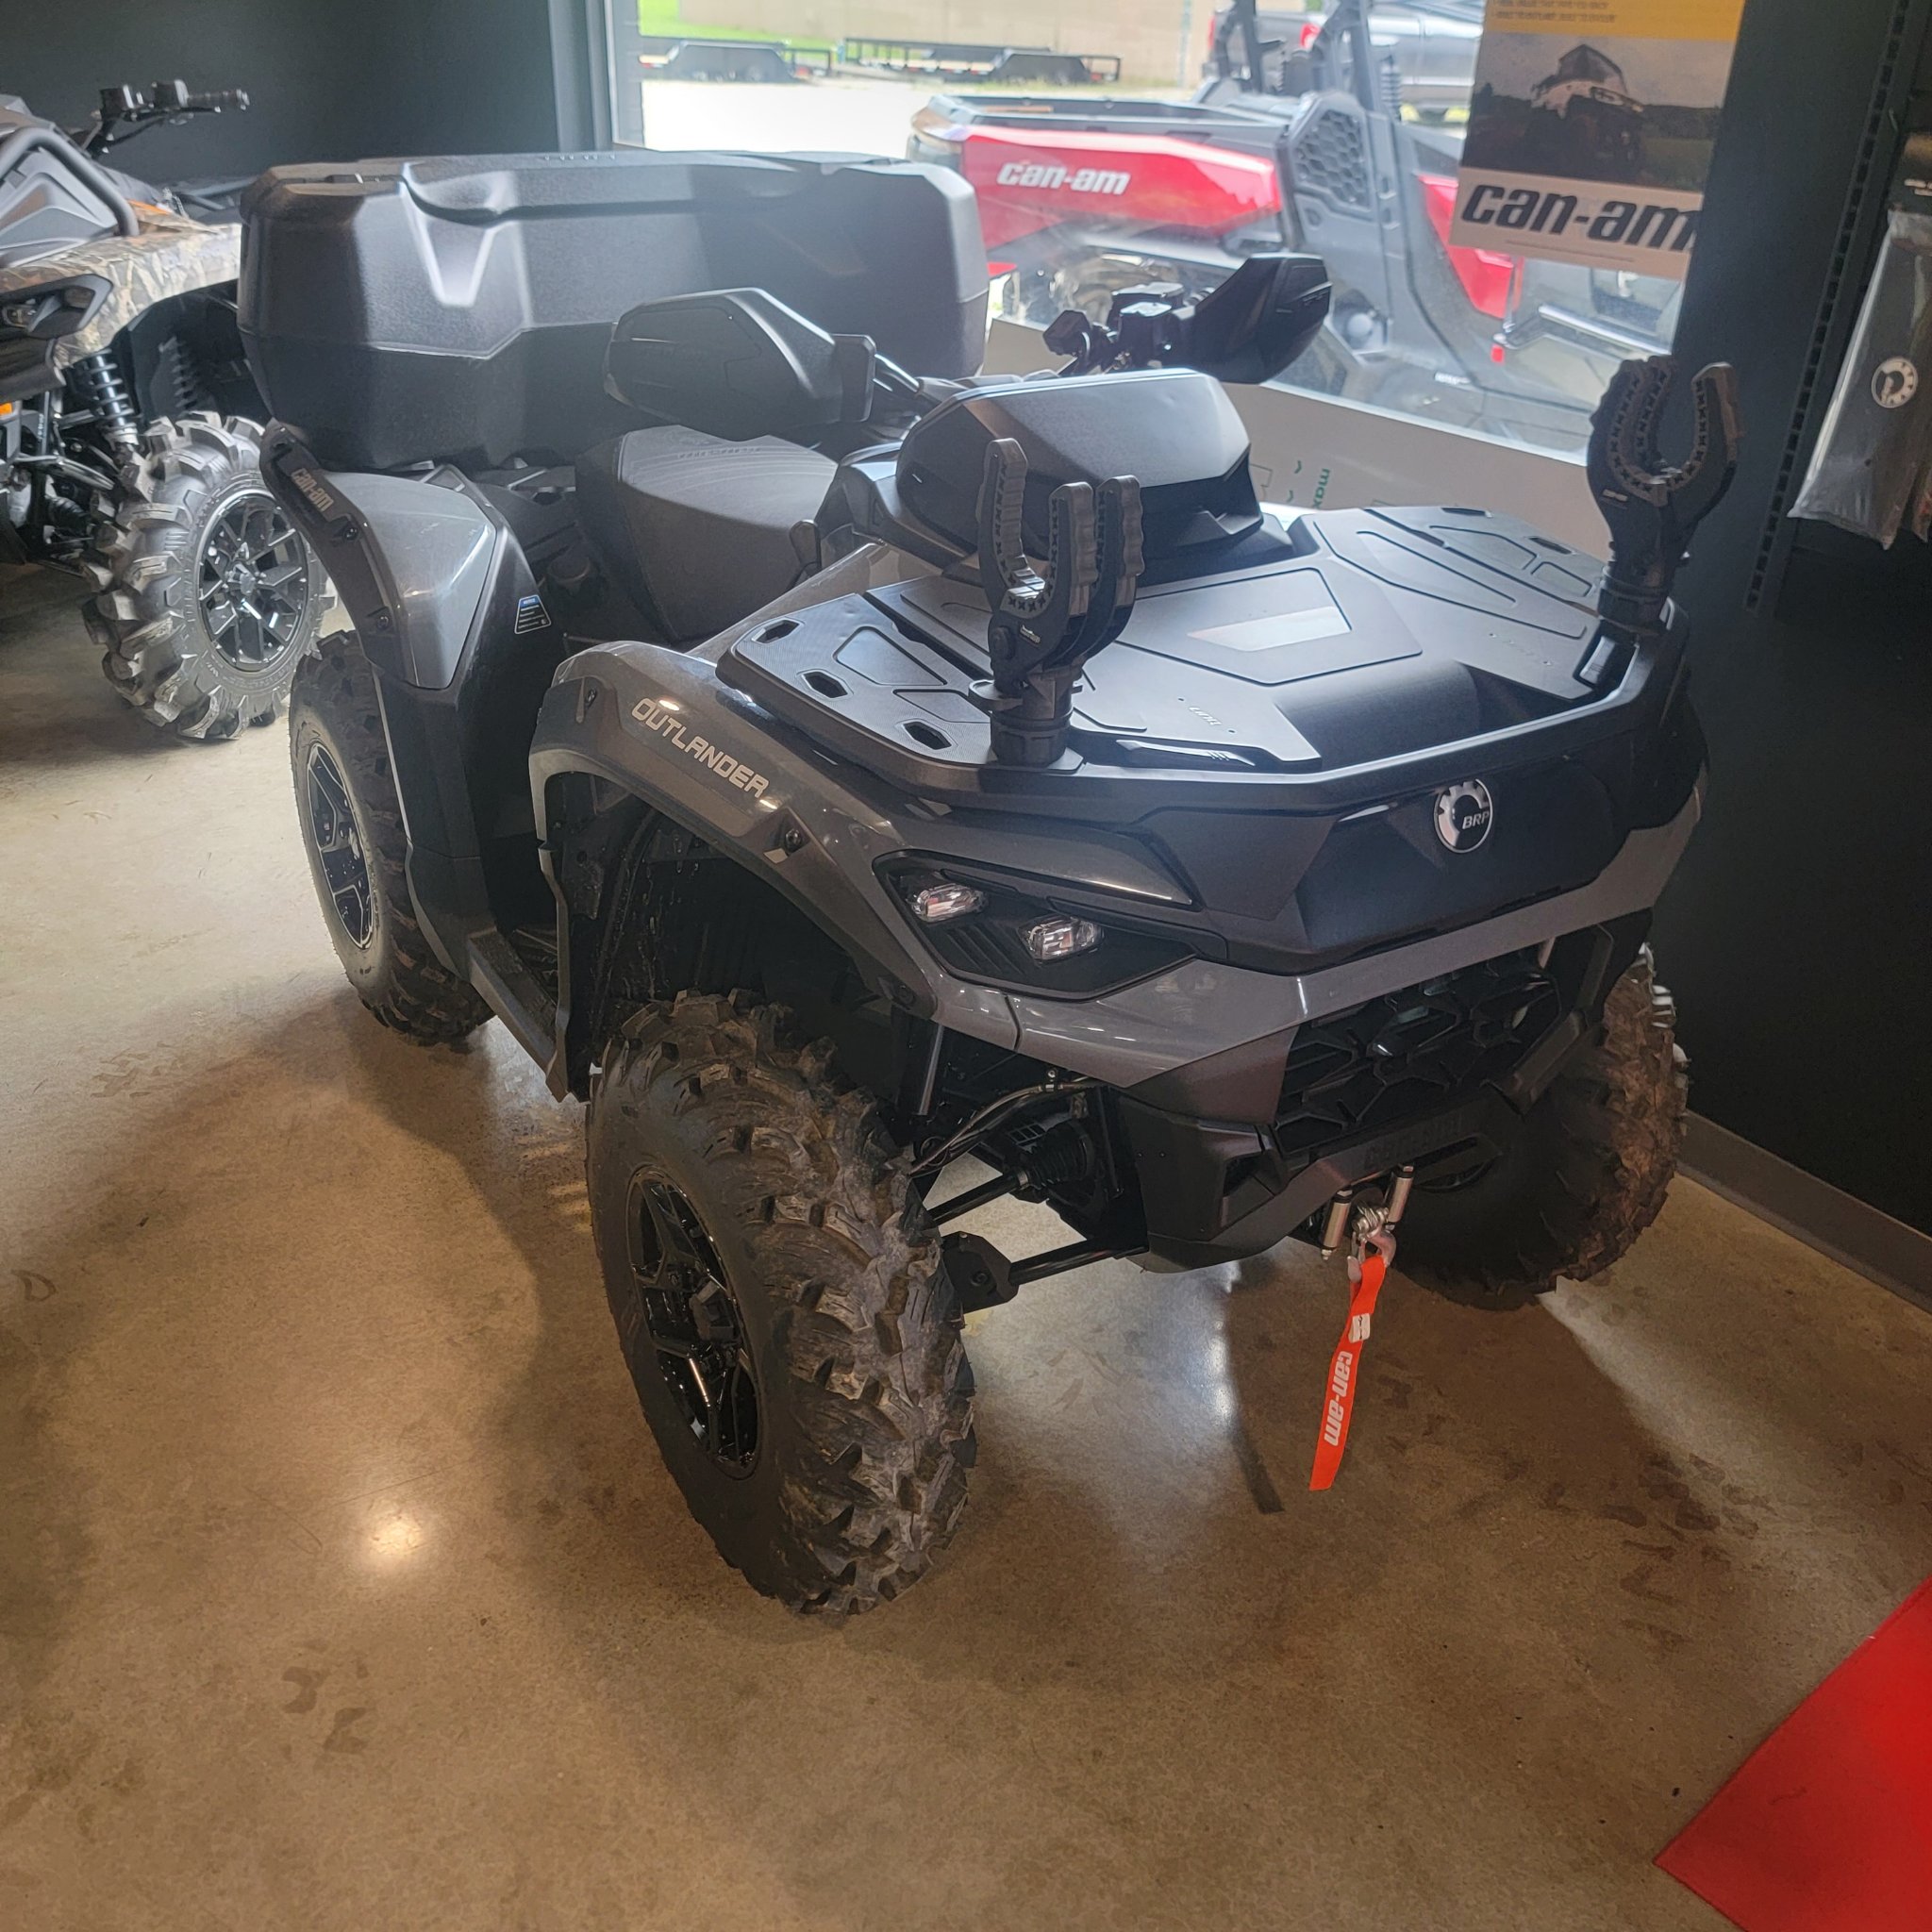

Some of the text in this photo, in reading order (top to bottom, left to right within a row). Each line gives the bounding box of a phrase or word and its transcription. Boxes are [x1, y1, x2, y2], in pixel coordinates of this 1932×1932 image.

[996, 162, 1131, 195] can-am
[1460, 184, 1702, 252] can-am
[291, 468, 334, 512] can-am
[631, 697, 769, 798] OUTLANDER
[1462, 811, 1490, 829] BRP
[1324, 1350, 1353, 1447] can-am
